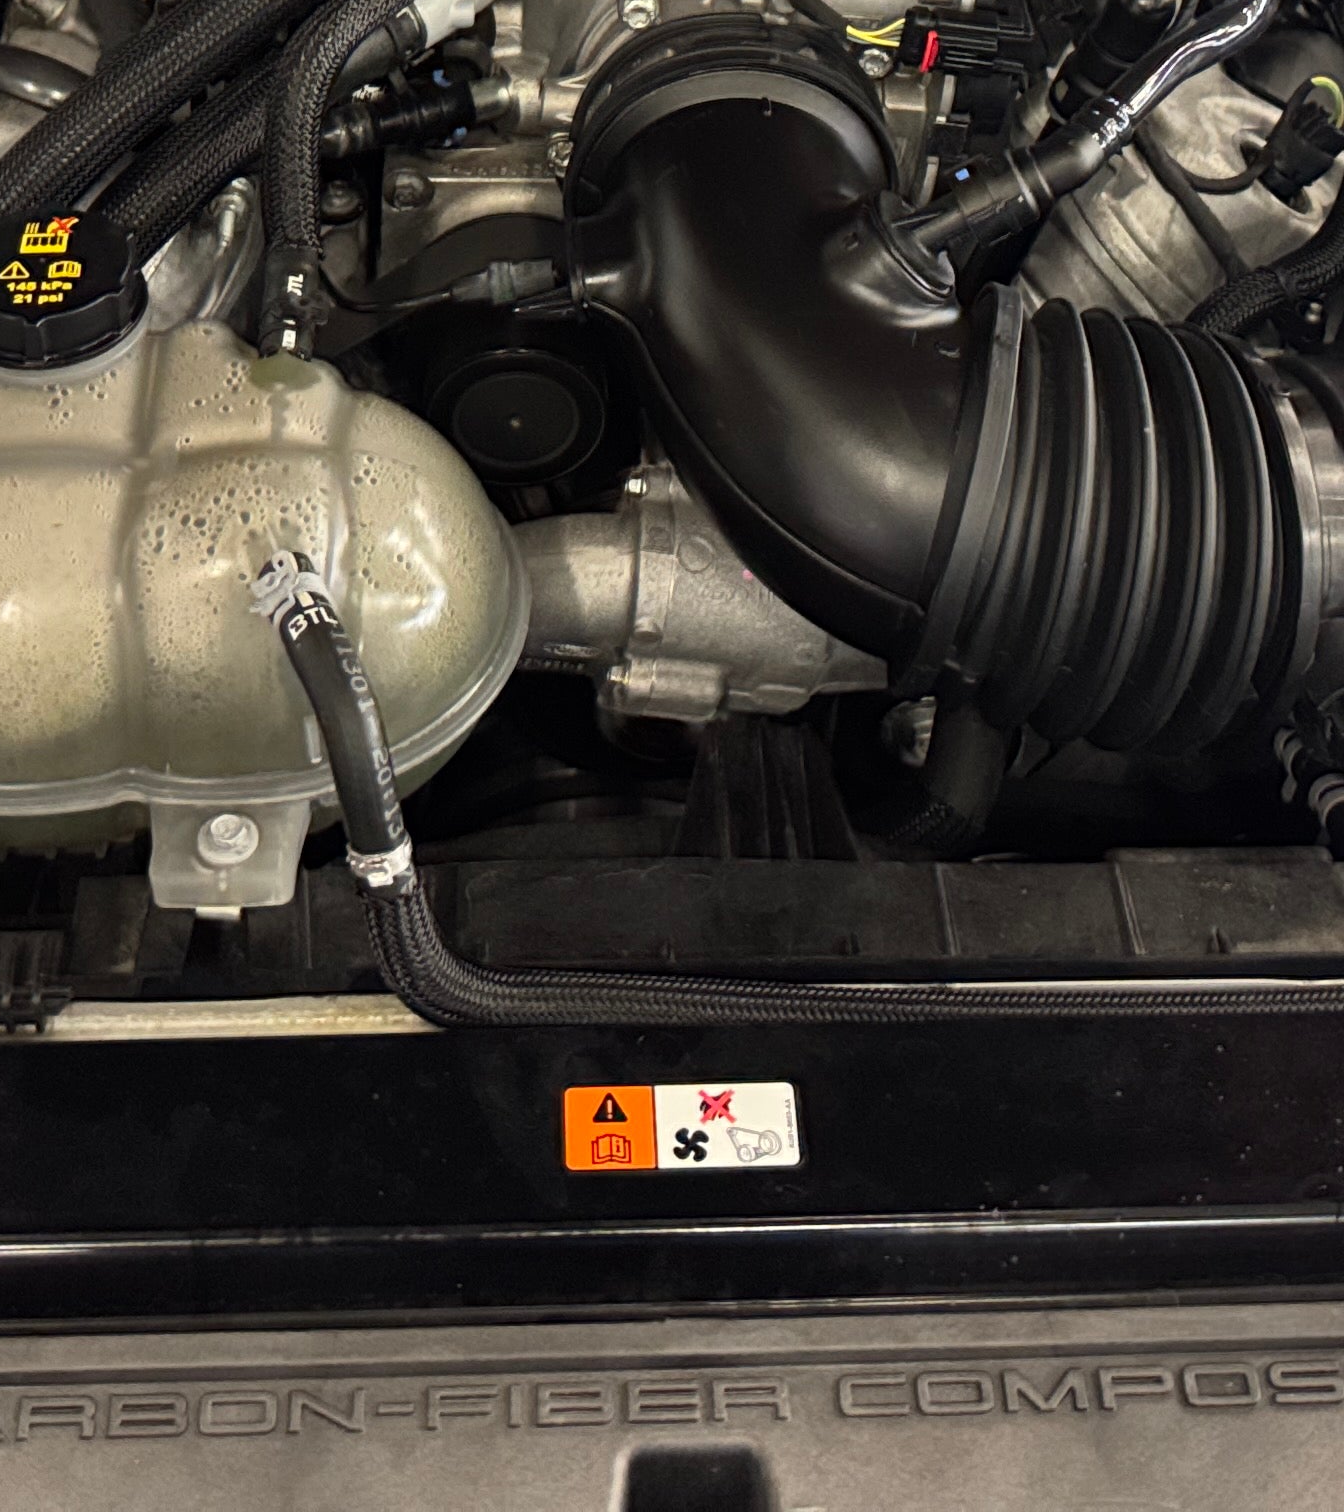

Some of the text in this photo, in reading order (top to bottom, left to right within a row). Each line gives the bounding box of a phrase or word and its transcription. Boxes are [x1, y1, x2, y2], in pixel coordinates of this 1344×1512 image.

[6, 280, 73, 292] 145 kPa
[13, 292, 64, 305] 21 psi
[288, 606, 338, 641] BTL
